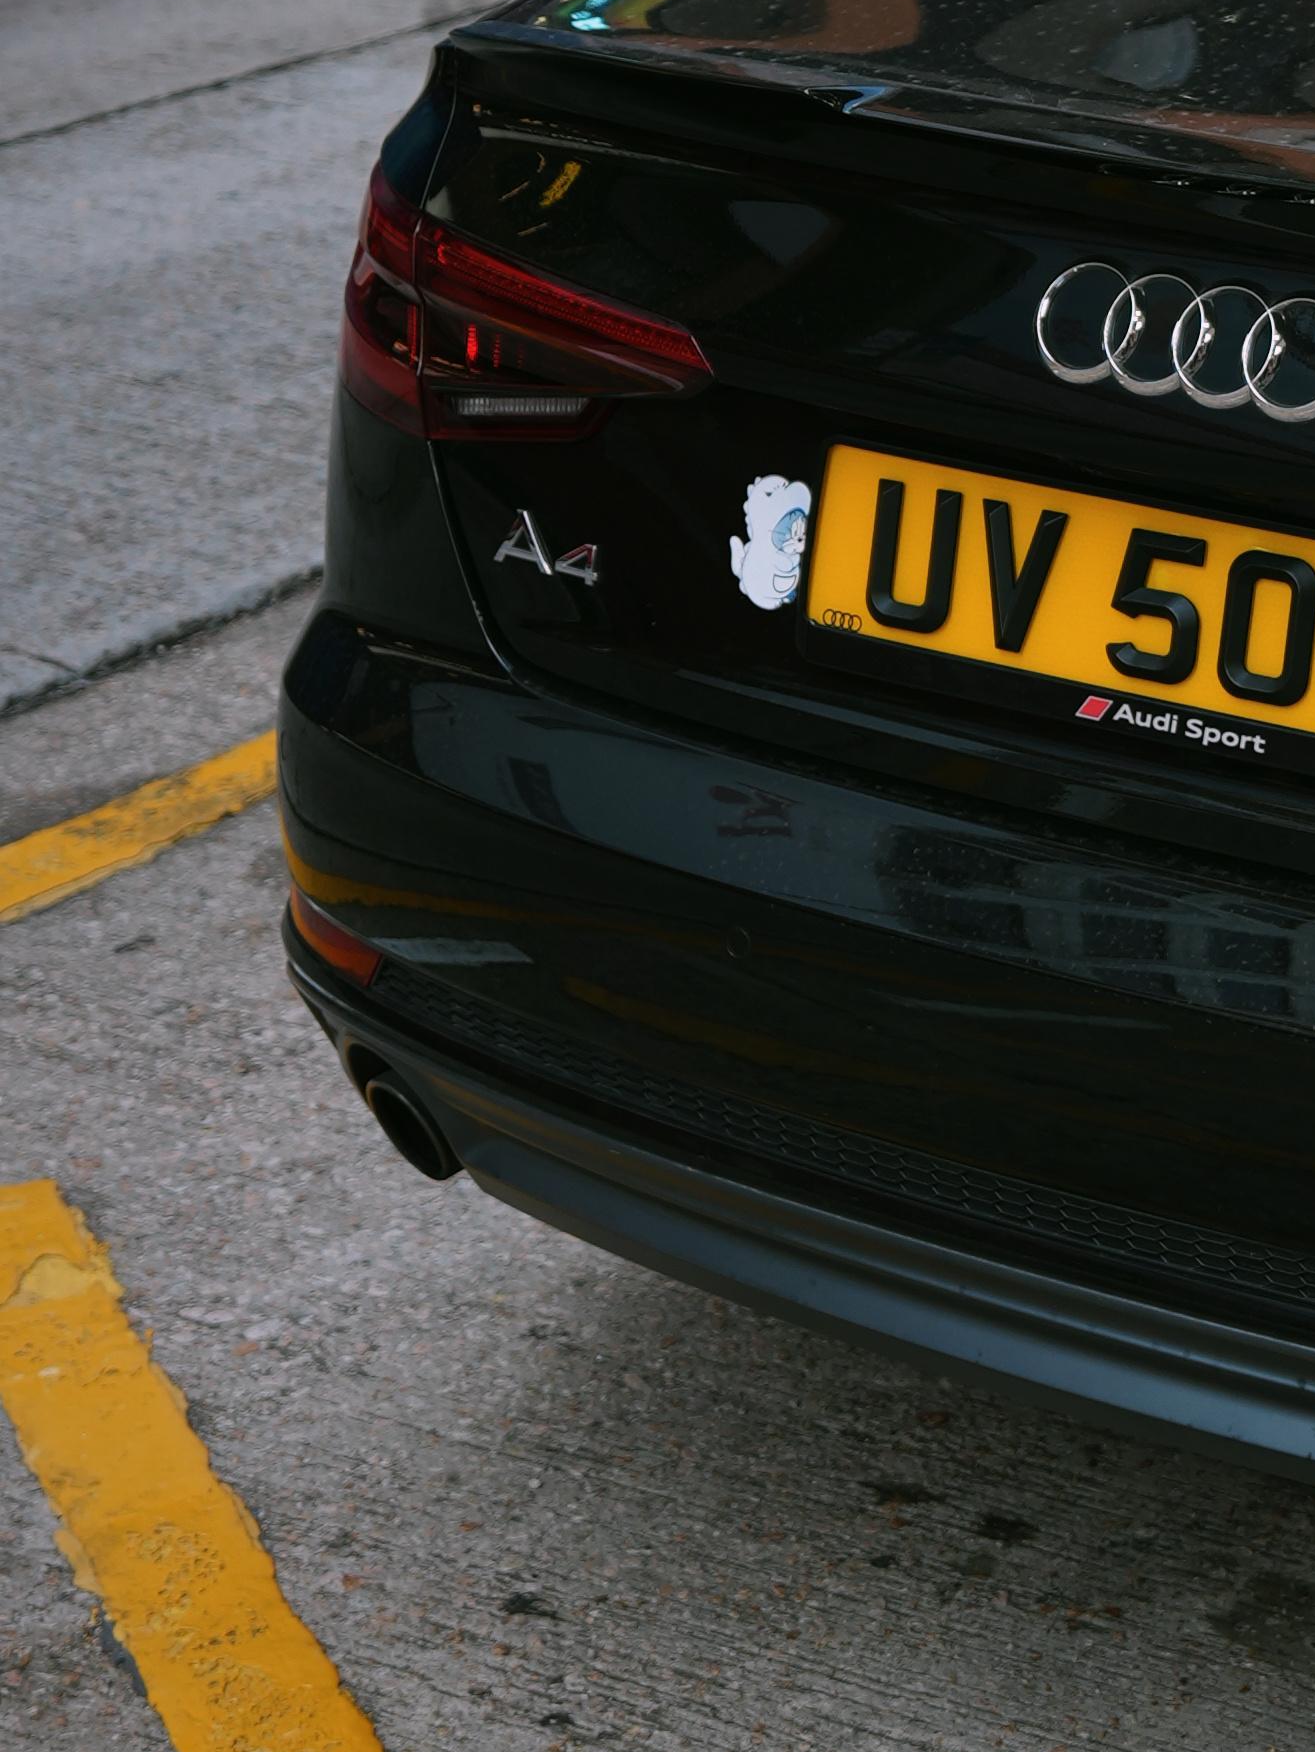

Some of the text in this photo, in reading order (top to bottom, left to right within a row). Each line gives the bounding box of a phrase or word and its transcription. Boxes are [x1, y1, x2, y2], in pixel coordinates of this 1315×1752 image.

[494, 508, 598, 586] A4
[865, 478, 1068, 653] UV
[1112, 704, 1266, 754] Audi Sport
